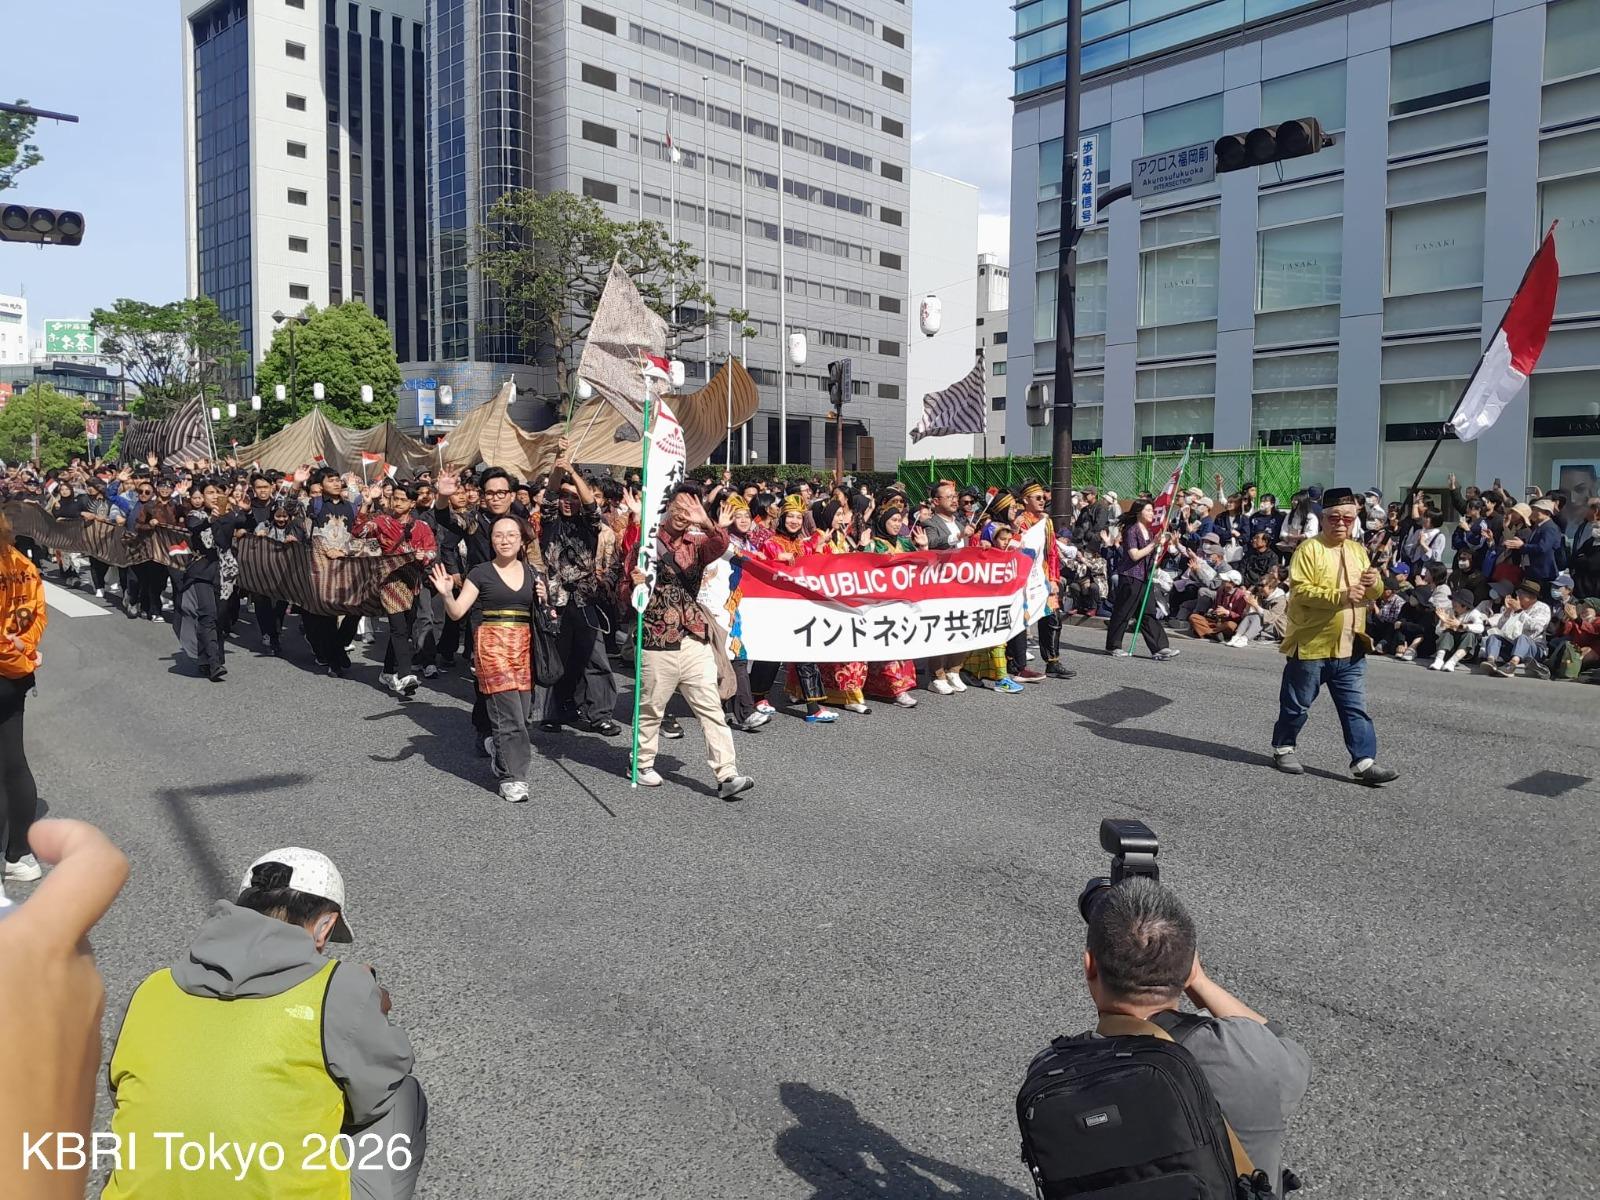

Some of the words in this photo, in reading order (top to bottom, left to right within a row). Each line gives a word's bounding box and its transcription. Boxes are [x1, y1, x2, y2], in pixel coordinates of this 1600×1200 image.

[1137, 146, 1209, 176] アクロス福岡前
[1142, 166, 1204, 186] Akurosufukuoka
[1081, 141, 1093, 222] 歩車分離信号
[1415, 239, 1456, 251] TASAKI
[1281, 258, 1318, 272] TASAKI
[774, 567, 888, 598] PUBLIC
[892, 564, 917, 590] OF
[920, 558, 1017, 586] INDONESI
[793, 604, 1012, 647] インドネシア共和国
